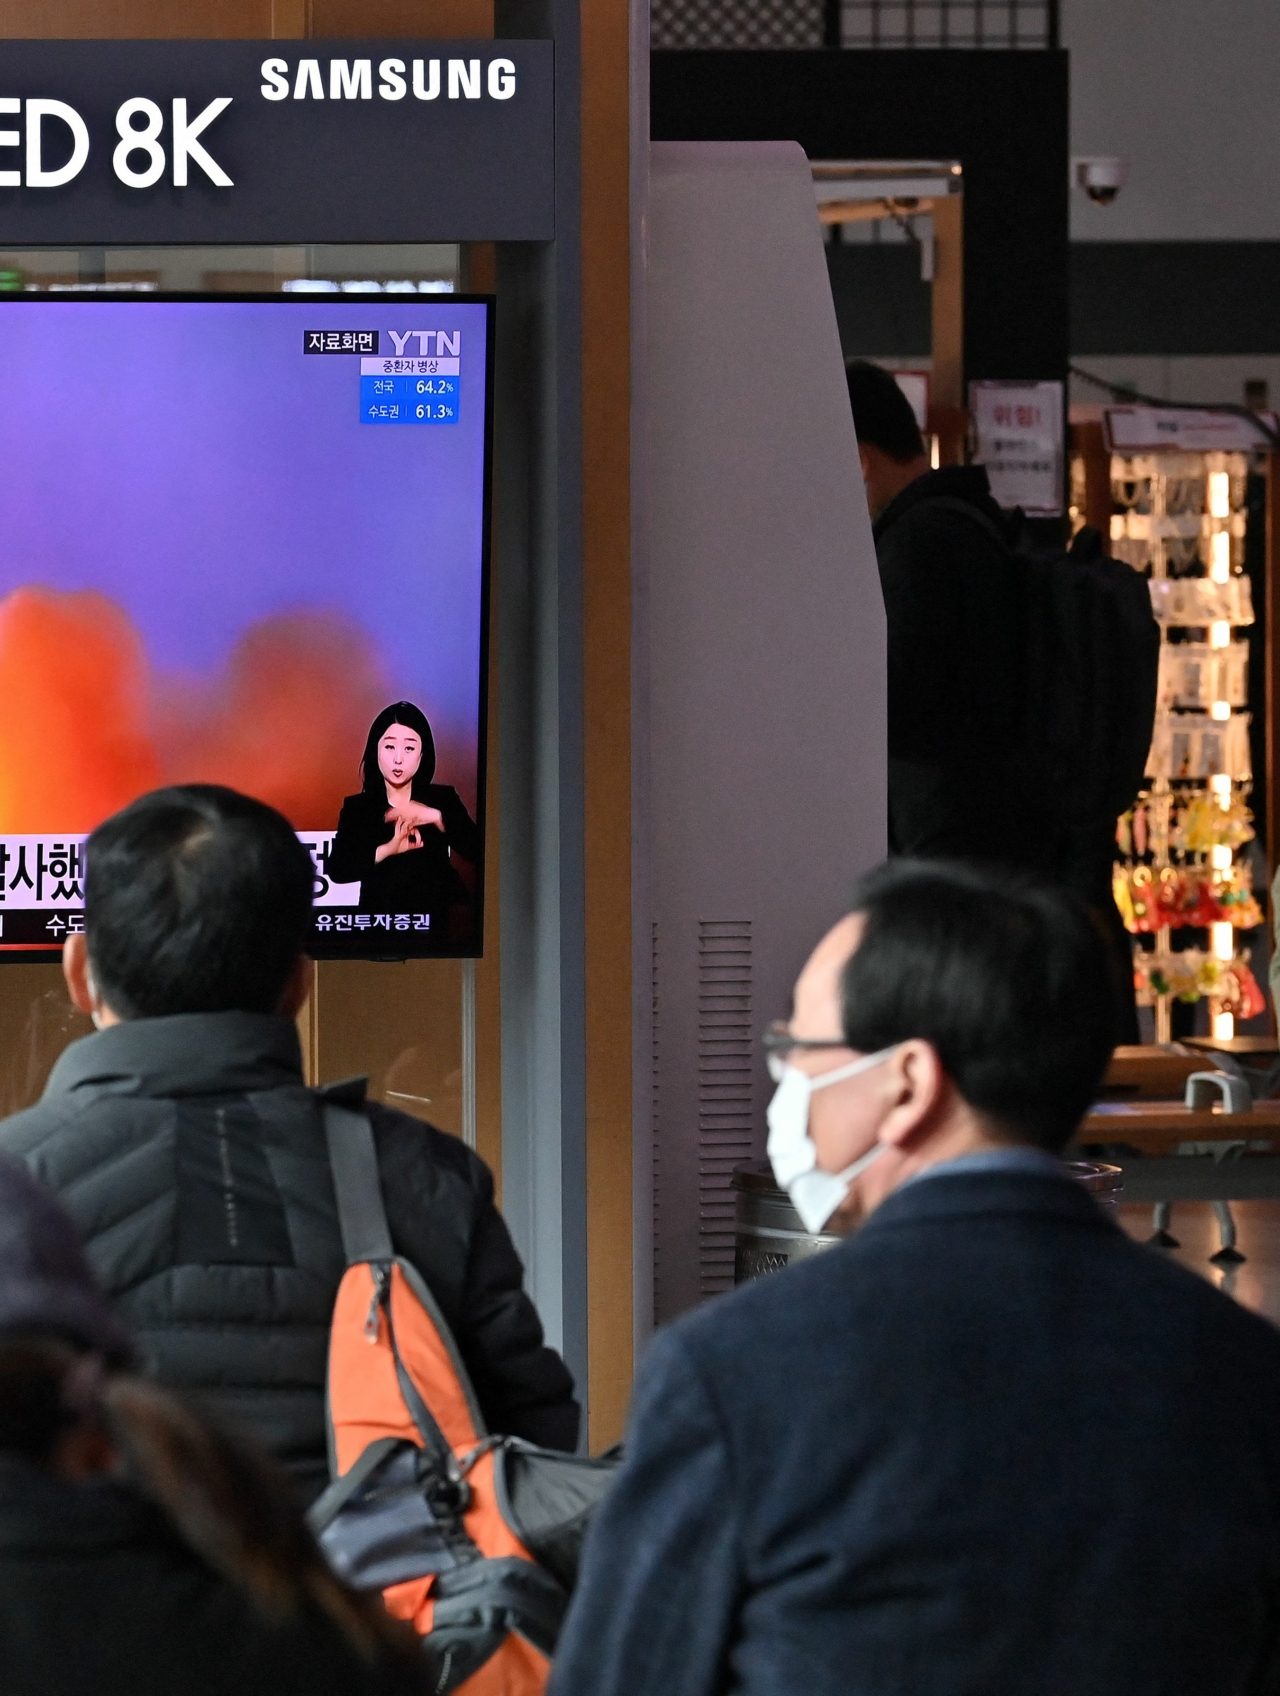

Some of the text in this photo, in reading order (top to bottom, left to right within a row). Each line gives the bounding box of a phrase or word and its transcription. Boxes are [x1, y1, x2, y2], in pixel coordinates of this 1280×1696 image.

[260, 57, 517, 101] SAMSUNG
[111, 96, 235, 189] 8K
[308, 333, 373, 352] 자료화면
[387, 330, 461, 357] YTN
[382, 360, 439, 374] 중환자 병상
[373, 380, 454, 395] 전국 64.2%
[368, 404, 454, 420] 수도권 61.3%
[315, 914, 430, 931] 유진투자증권
